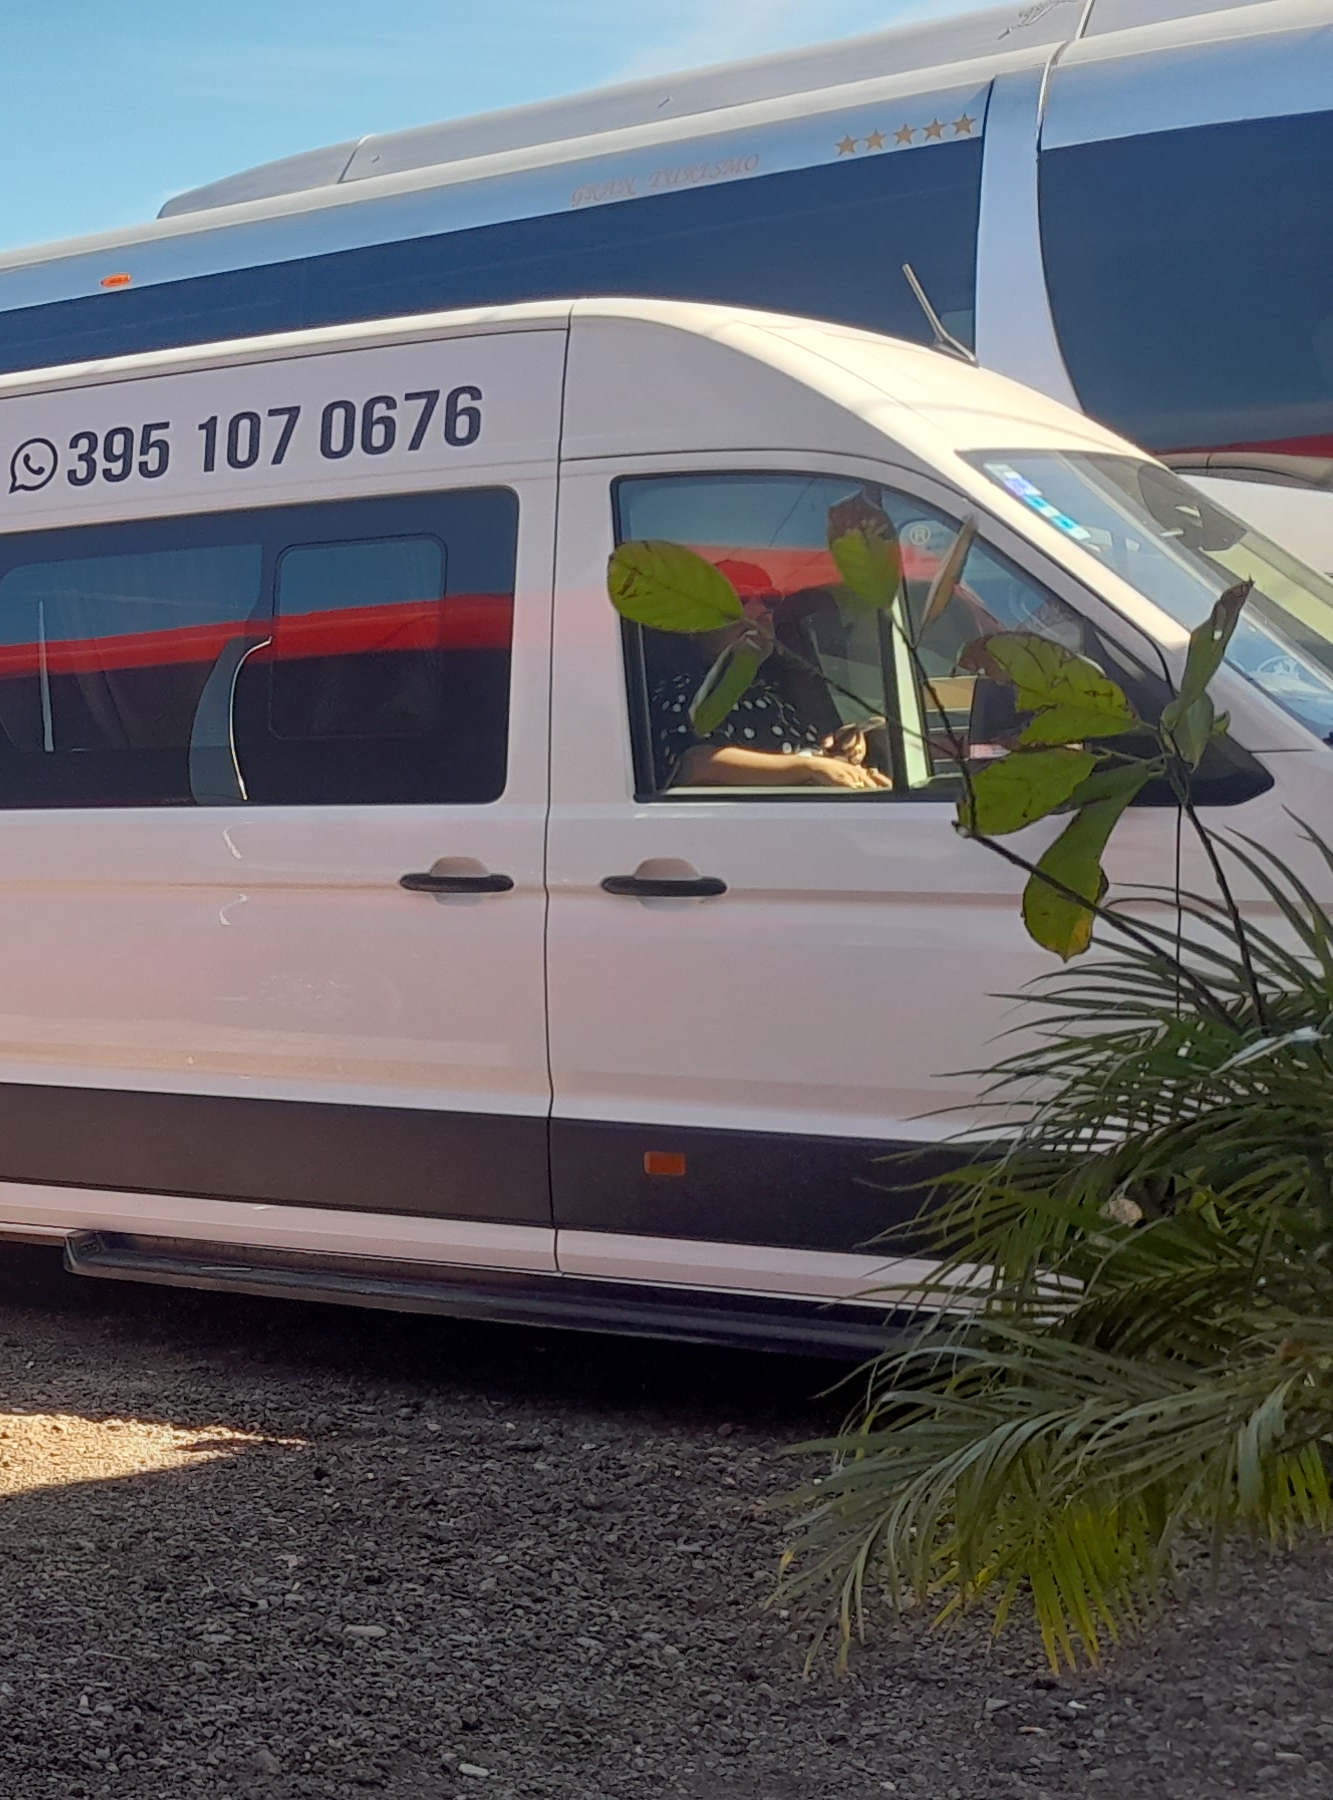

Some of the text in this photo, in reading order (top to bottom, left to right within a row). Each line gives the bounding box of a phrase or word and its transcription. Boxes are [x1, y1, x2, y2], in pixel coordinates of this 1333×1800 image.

[570, 152, 761, 208] GRAN TURISMO
[66, 385, 484, 488] 395 107 0676
